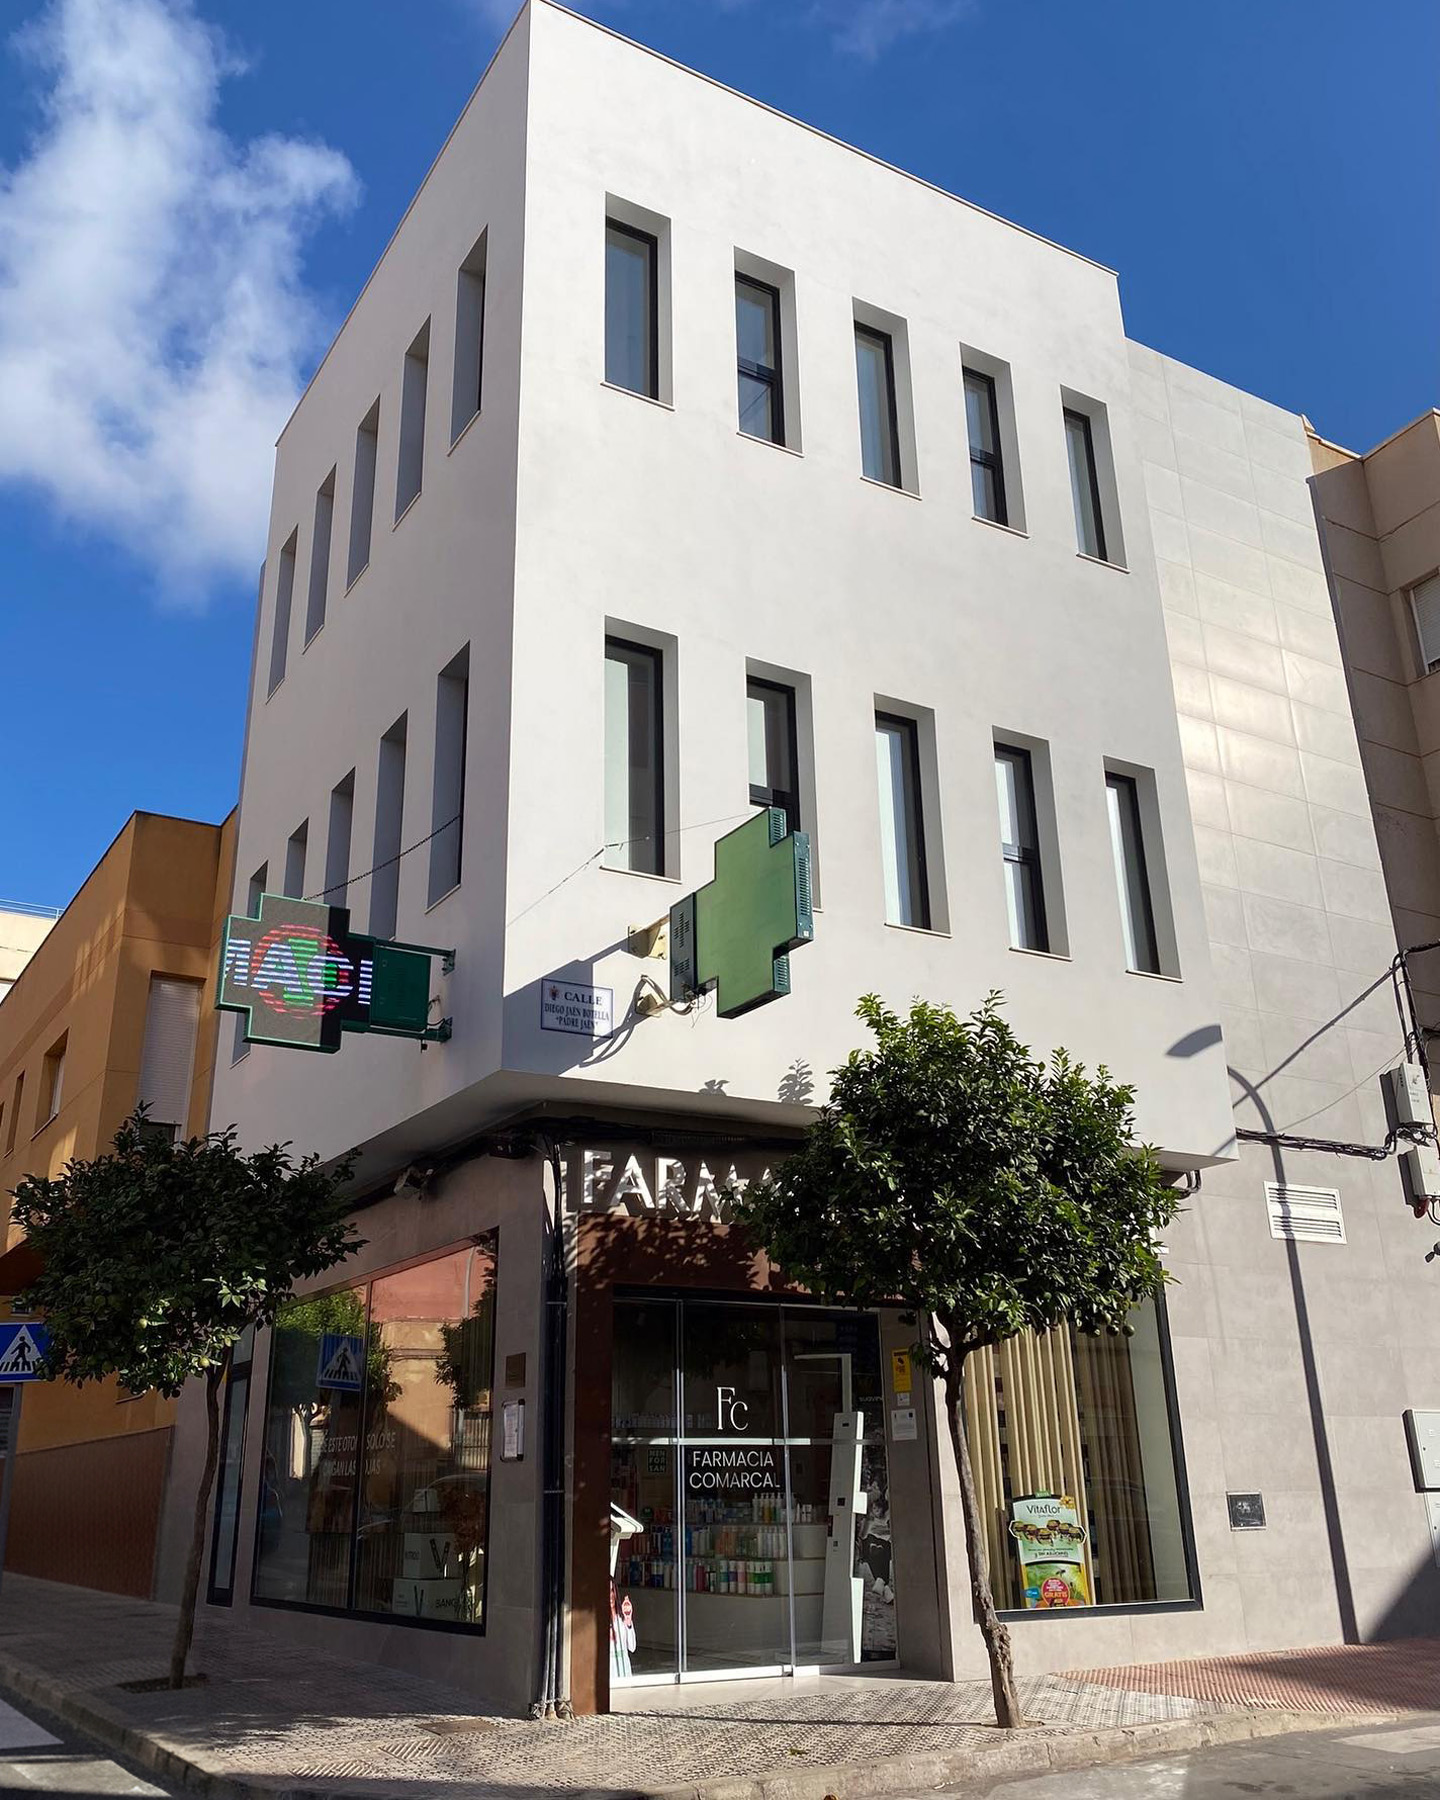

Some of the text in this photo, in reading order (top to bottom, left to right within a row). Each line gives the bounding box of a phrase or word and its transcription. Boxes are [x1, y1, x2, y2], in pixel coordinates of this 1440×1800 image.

[564, 991, 603, 1005] CALLE
[544, 1002, 565, 1014] DIEGO
[582, 1008, 609, 1021] BOTELLA
[692, 1450, 774, 1467] FARMACIA
[689, 1471, 780, 1488] COMARCAL
